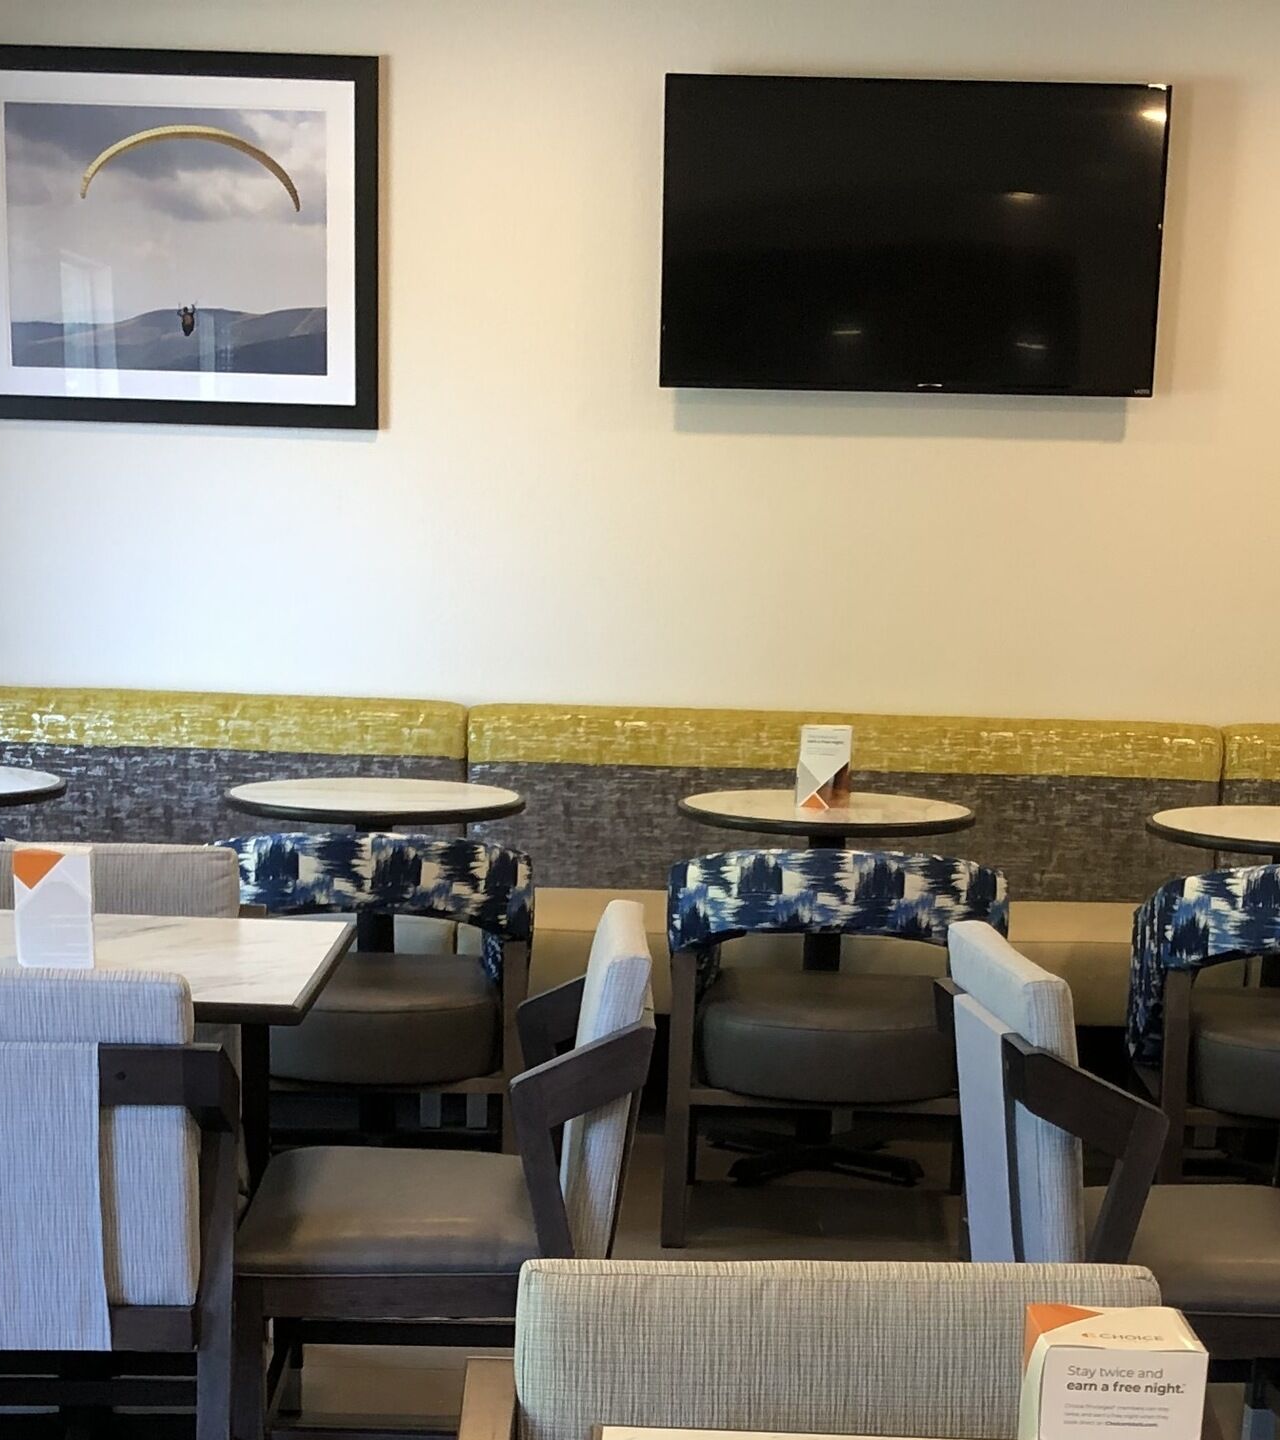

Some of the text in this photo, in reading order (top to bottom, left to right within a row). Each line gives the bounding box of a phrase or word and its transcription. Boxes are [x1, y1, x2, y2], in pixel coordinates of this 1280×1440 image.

[1099, 1333, 1164, 1341] CHOICE
[1067, 1365, 1163, 1379] Stay twice and
[1066, 1382, 1097, 1391] earn
[1101, 1383, 1109, 1391] a
[1113, 1381, 1141, 1392] free
